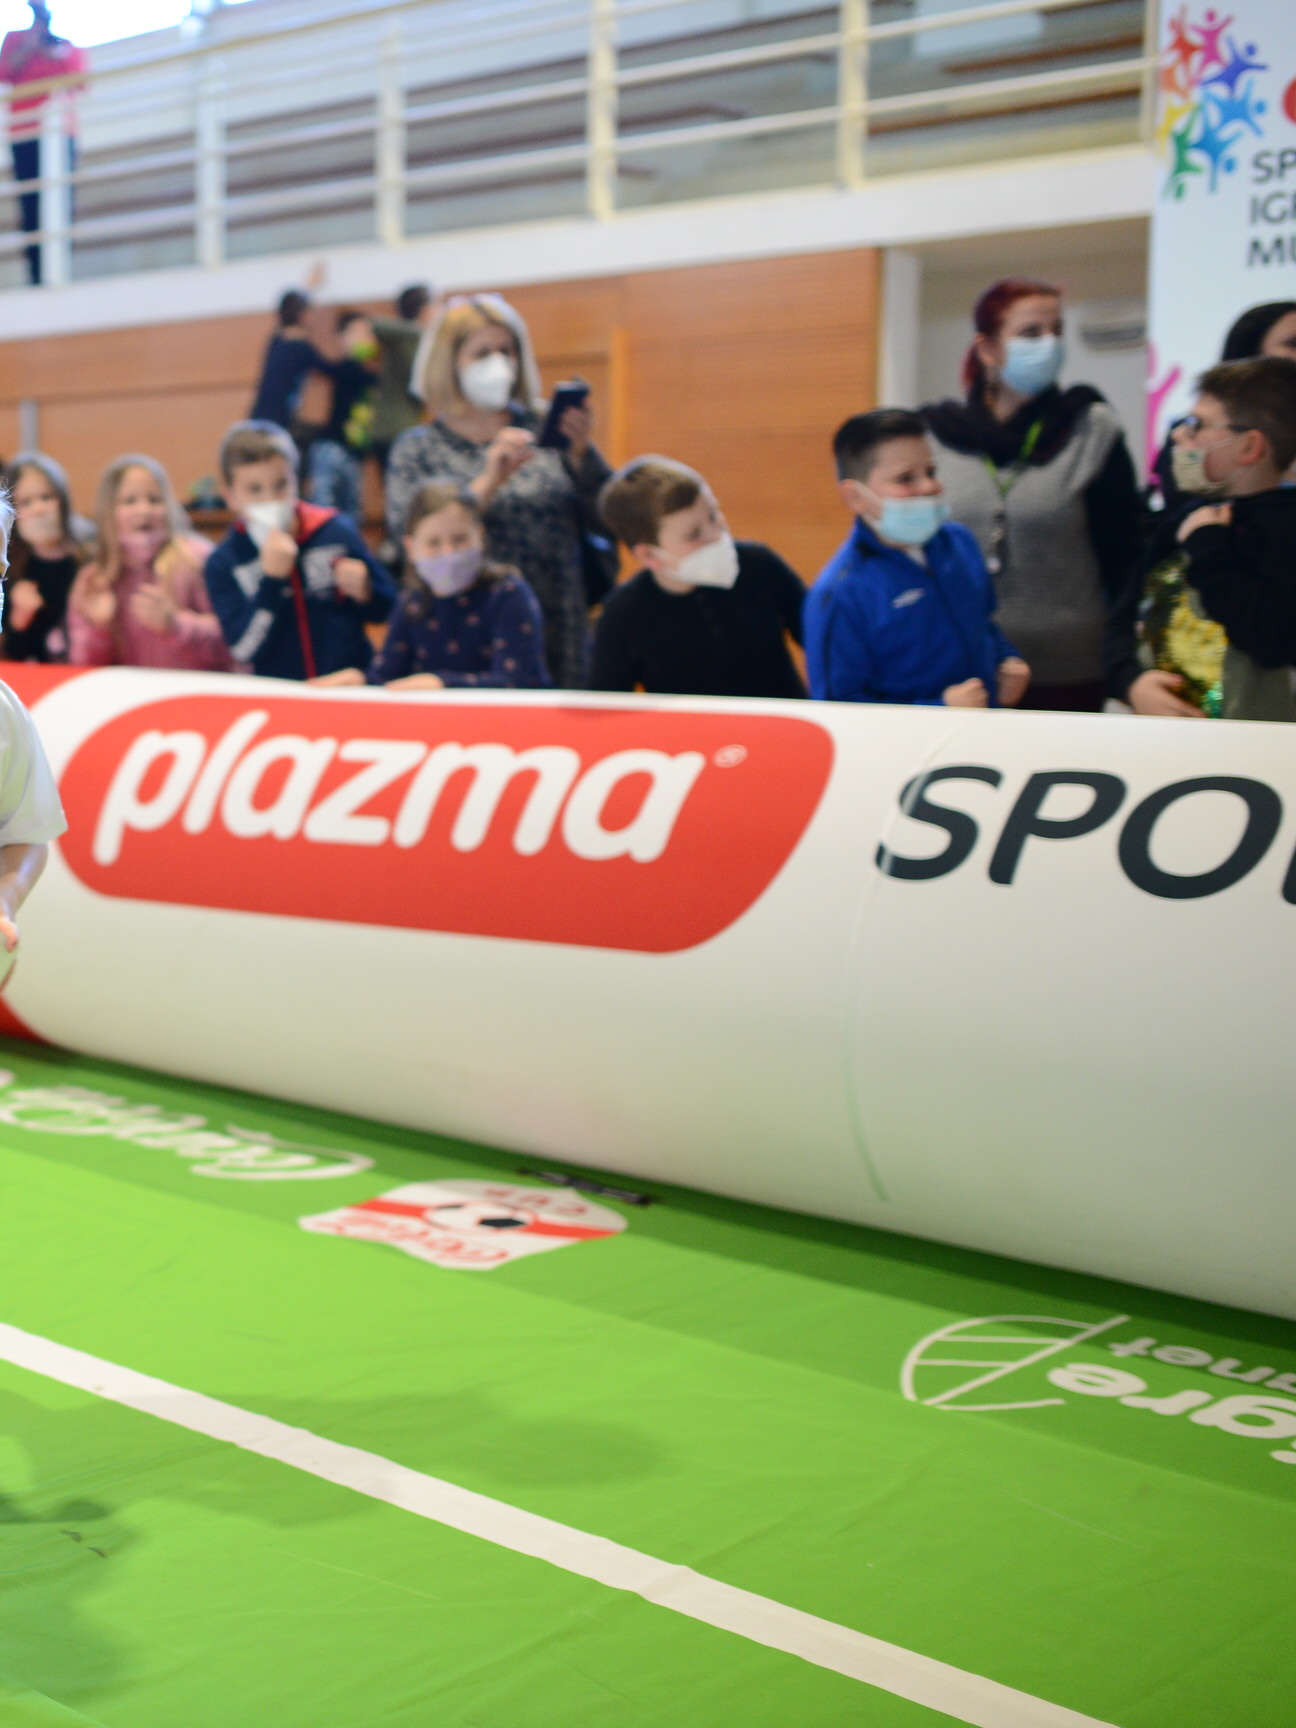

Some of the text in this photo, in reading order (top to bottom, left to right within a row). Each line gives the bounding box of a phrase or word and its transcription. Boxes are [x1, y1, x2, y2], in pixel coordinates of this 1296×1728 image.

[1247, 235, 1296, 268] M
[1249, 191, 1296, 227] IG
[92, 710, 706, 866] plazma
[874, 763, 1296, 906] SPO
